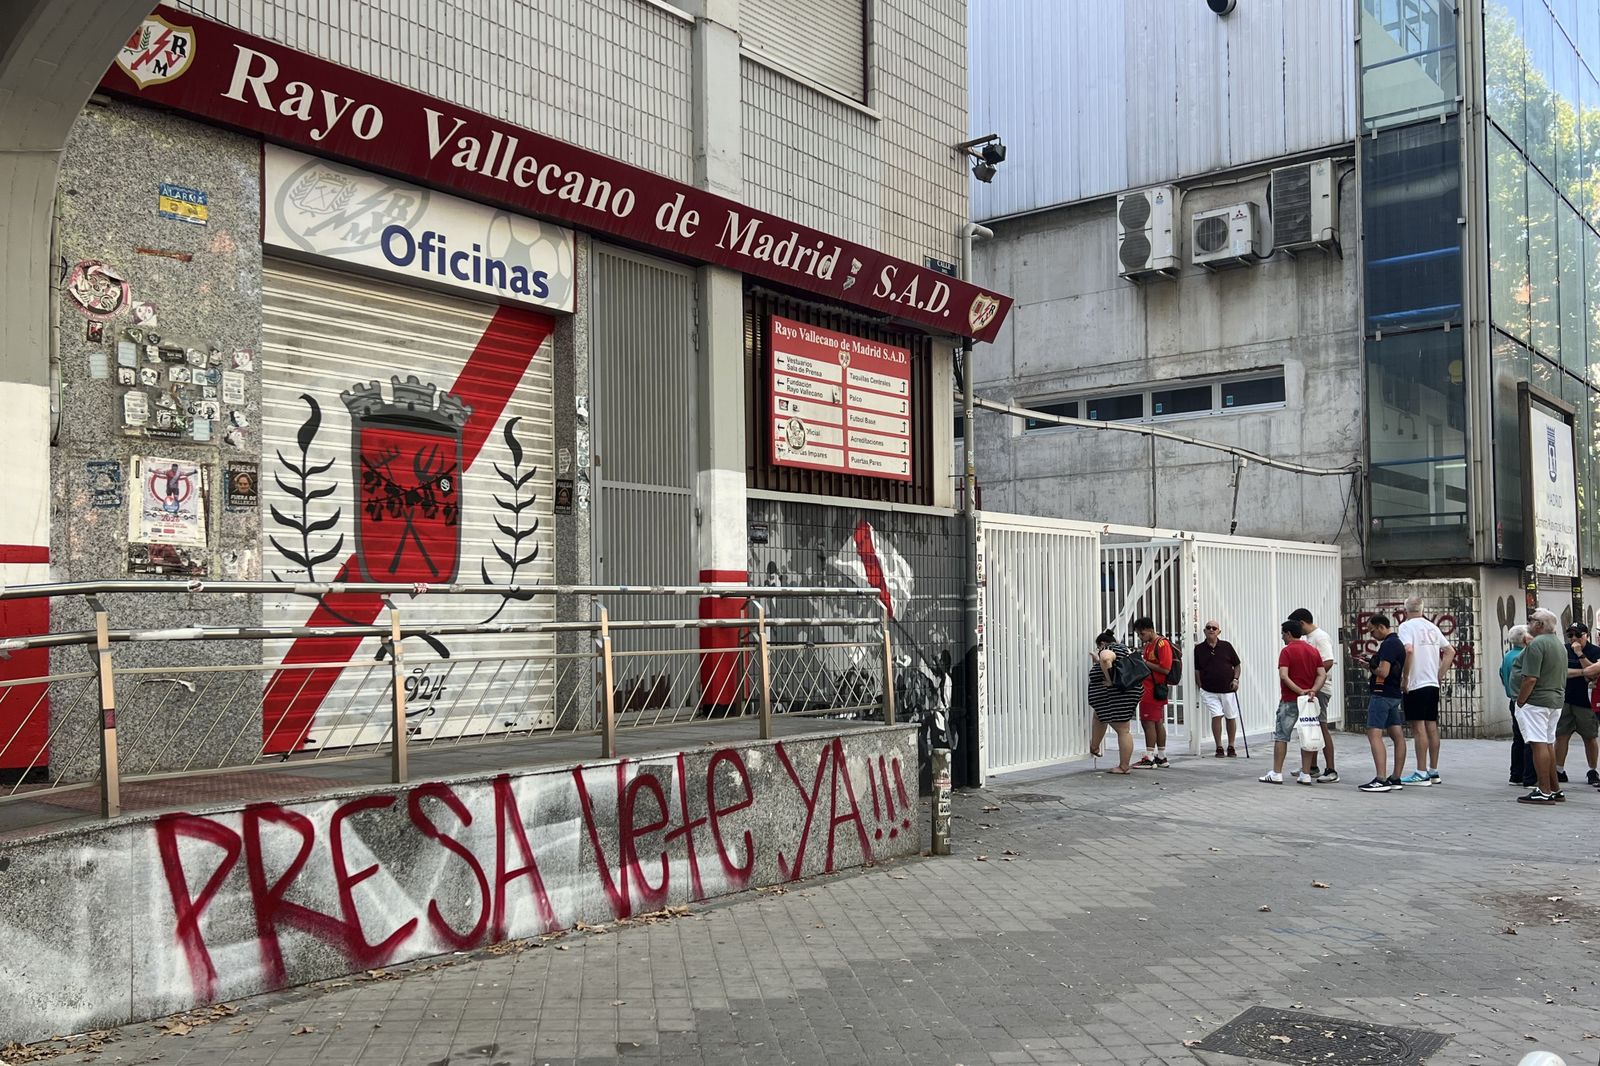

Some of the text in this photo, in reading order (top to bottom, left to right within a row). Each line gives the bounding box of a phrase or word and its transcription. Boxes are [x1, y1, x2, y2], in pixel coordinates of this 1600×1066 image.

[220, 44, 950, 317] Rayo Vallecano de Madrid S.A.D.
[380, 224, 550, 299] Oficinas
[774, 321, 907, 364] Rayo Vallecano de Madrid S.A.D.
[786, 356, 813, 368] Vestuarios
[786, 363, 798, 372] Sala
[805, 368, 823, 377] Prensa
[850, 372, 891, 387] Taquillas Centrales
[786, 385, 824, 398] Rayo Vallecano
[850, 394, 862, 403] Palco
[850, 435, 884, 446] Acreditaciones
[851, 456, 868, 465] Puertas
[230, 464, 257, 473] PRESA
[154, 773, 558, 1001] PRESA
